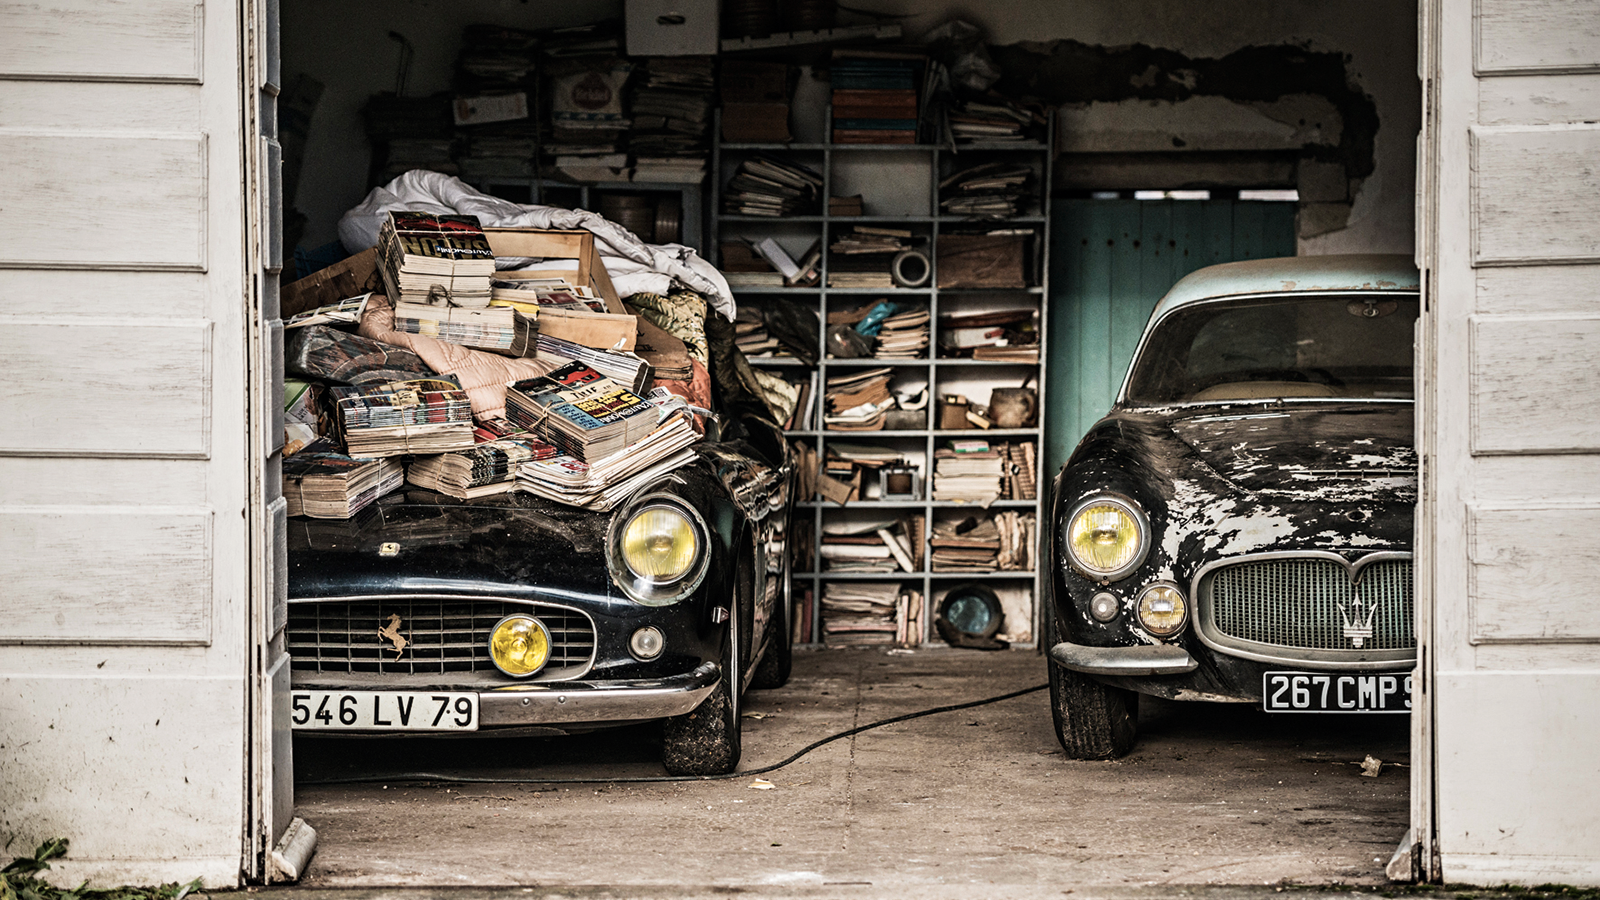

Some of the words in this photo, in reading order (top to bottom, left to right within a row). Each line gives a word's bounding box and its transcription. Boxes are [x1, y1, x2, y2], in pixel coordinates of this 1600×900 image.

[620, 393, 641, 406] 5
[292, 694, 358, 725] 546
[373, 695, 414, 726] LV
[431, 695, 473, 727] 79
